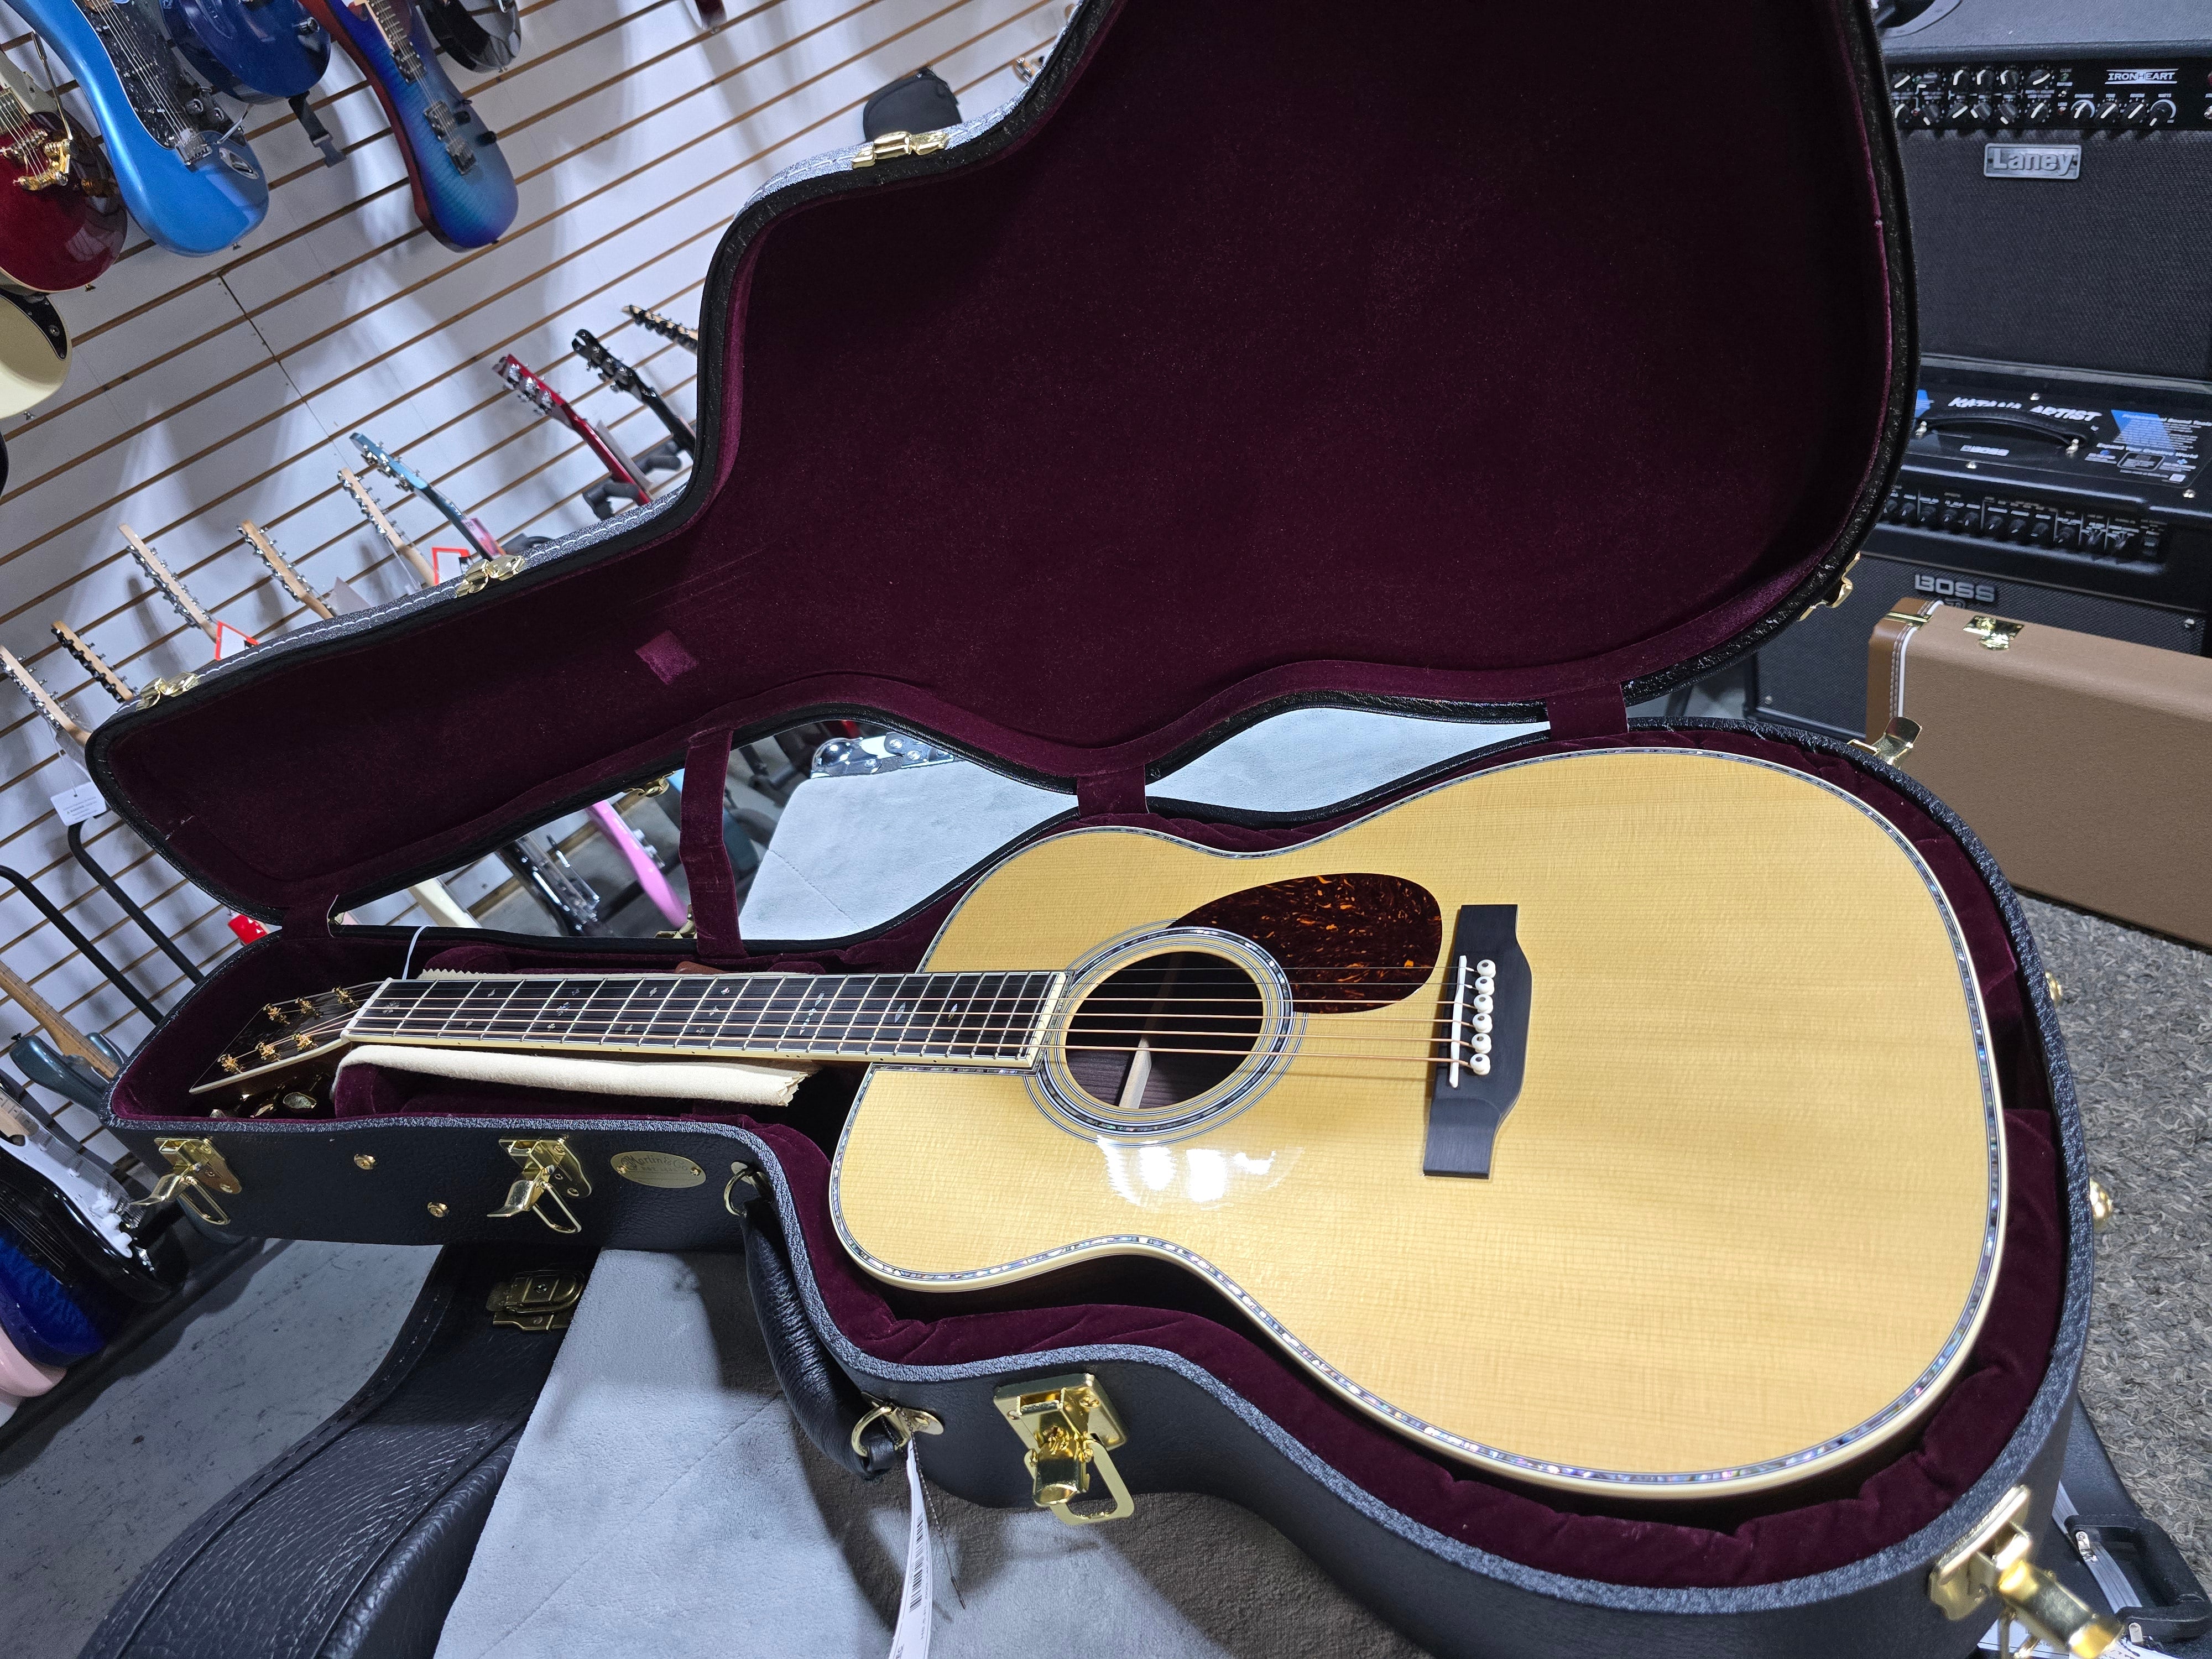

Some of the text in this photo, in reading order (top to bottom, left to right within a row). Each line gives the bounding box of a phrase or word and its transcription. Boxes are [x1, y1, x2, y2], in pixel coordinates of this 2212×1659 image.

[2107, 71, 2176, 81] IRONHEART
[1993, 148, 2074, 176] Laney
[1914, 573, 1995, 603] BOSS
